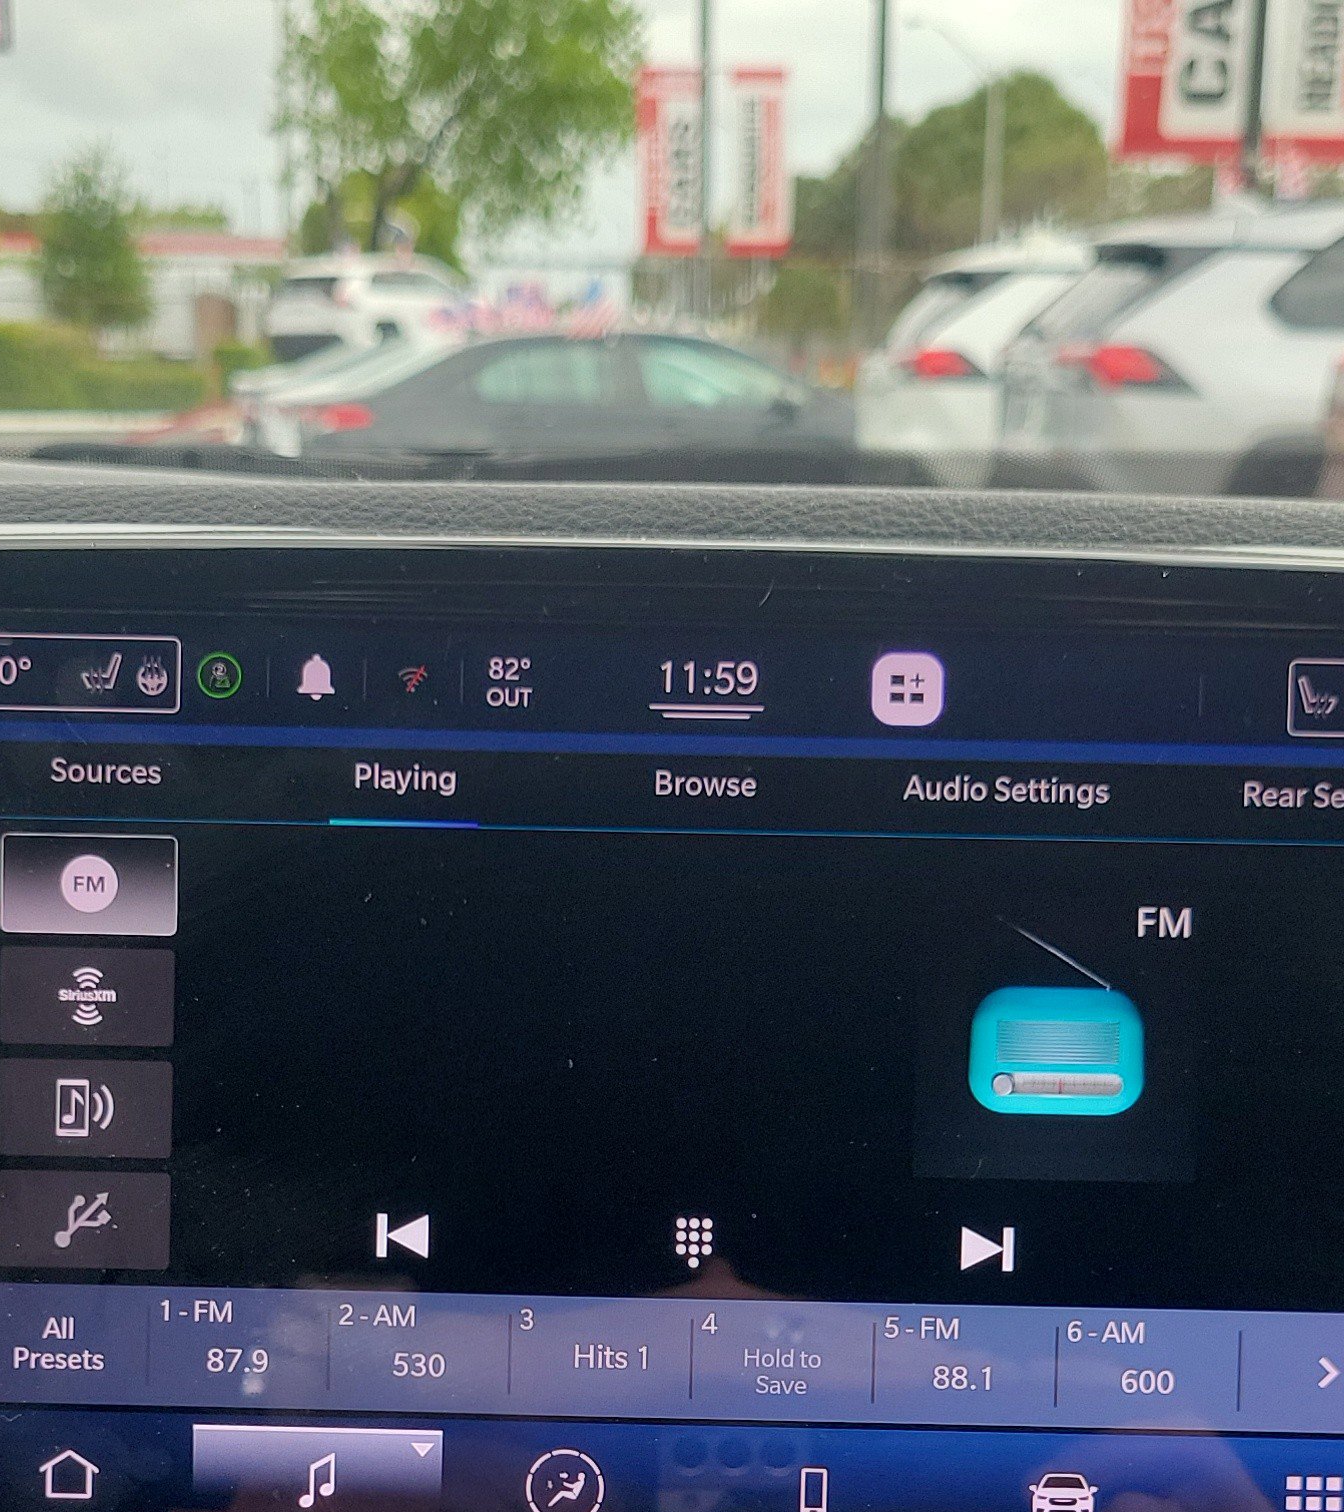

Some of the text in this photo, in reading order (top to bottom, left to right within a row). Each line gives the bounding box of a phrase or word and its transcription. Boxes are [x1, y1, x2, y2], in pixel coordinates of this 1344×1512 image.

[489, 658, 530, 680] 82°
[661, 661, 757, 694] 11:59
[487, 688, 532, 707] OUT
[51, 758, 161, 784] Sources
[355, 763, 456, 796] Playing
[656, 770, 756, 796] Browse
[904, 775, 1109, 808] Audio Settings
[1244, 781, 1307, 807] Rear
[74, 876, 104, 892] FM
[1138, 907, 1191, 938] FM
[43, 1317, 73, 1339] All
[521, 1309, 533, 1330] 3
[702, 1314, 717, 1334] 4
[14, 1347, 104, 1370] Presets
[207, 1349, 267, 1375] 87.9
[393, 1353, 444, 1377] 530
[575, 1345, 646, 1369] Hits 1
[743, 1348, 820, 1368] Hold to
[756, 1376, 806, 1394] Save
[934, 1366, 990, 1390] 88.1
[1122, 1370, 1173, 1394] 600
